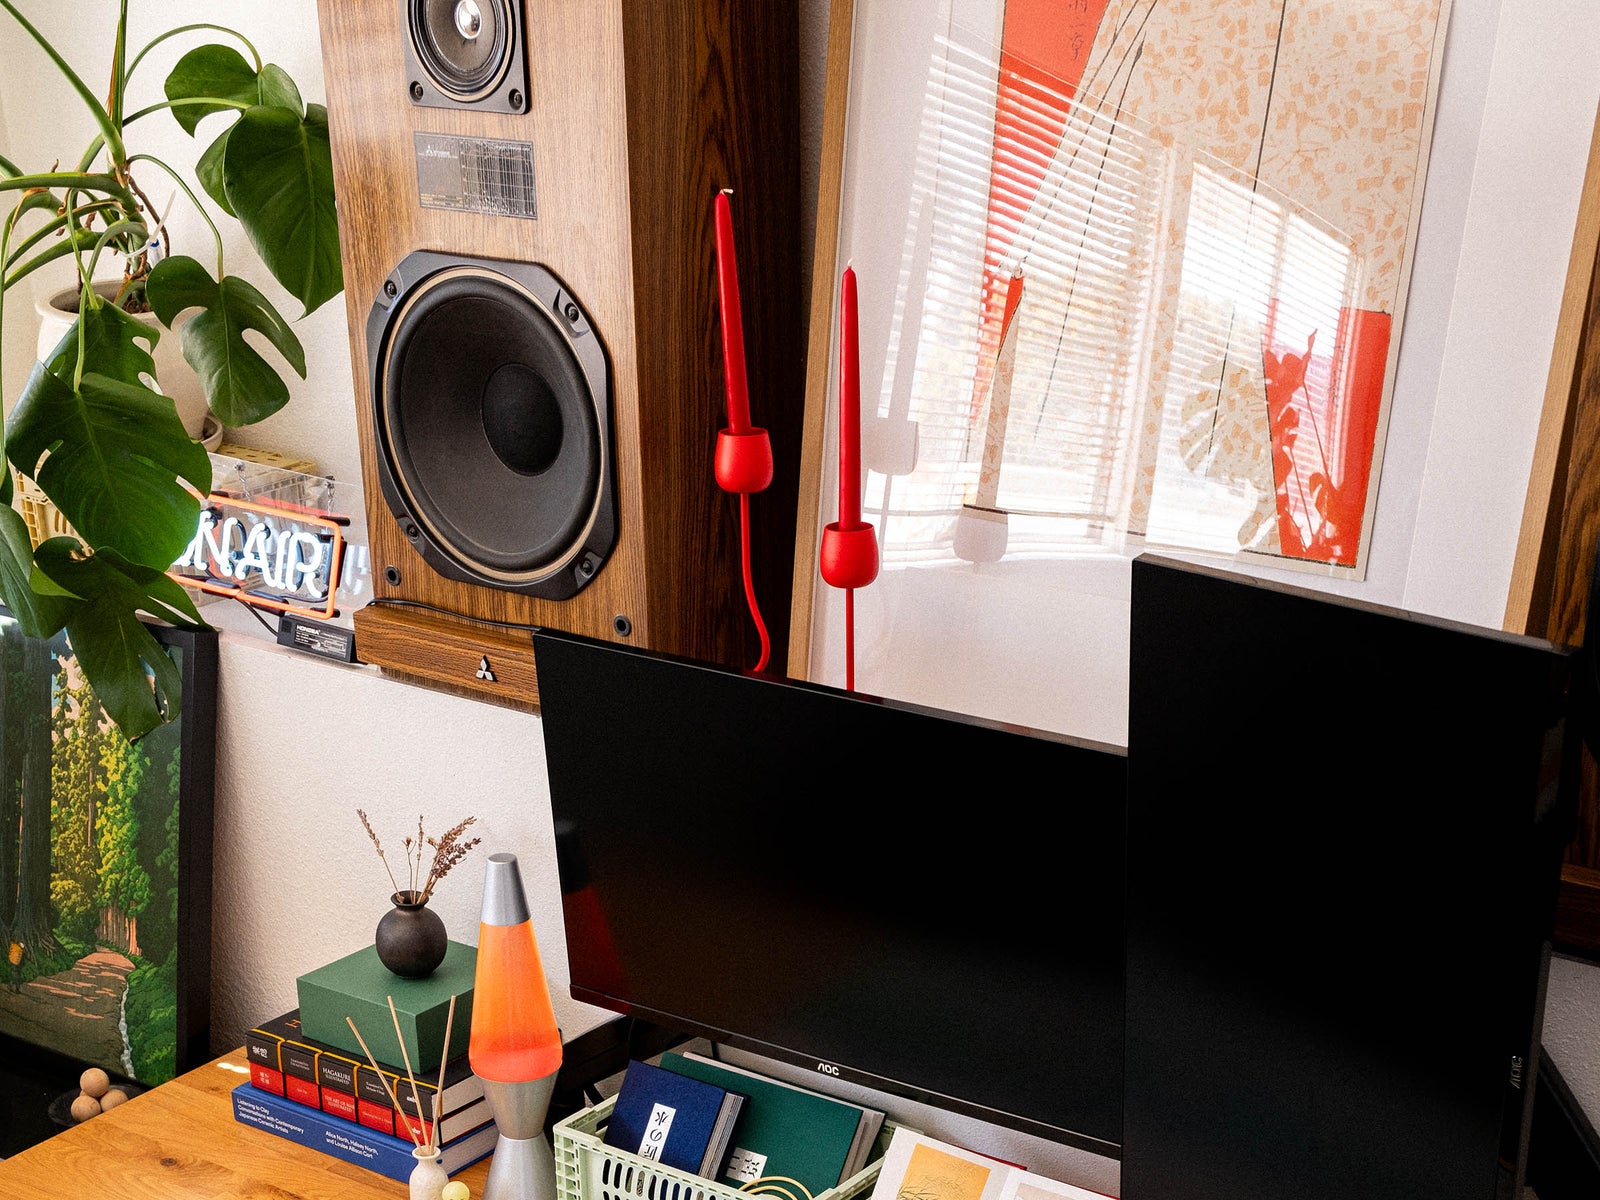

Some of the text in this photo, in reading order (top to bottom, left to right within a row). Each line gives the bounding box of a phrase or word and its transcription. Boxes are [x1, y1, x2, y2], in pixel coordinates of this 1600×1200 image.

[173, 510, 323, 599] N AIR
[817, 1062, 840, 1076] AOC
[236, 1098, 256, 1110] Listening
[260, 1106, 270, 1115] Clay
[238, 1104, 267, 1119] Conversations
[275, 1118, 304, 1134] Contemporary
[239, 1111, 289, 1134] Japanese Ceramic Artists
[325, 1130, 336, 1139] Alice
[334, 1139, 349, 1150] Louise
